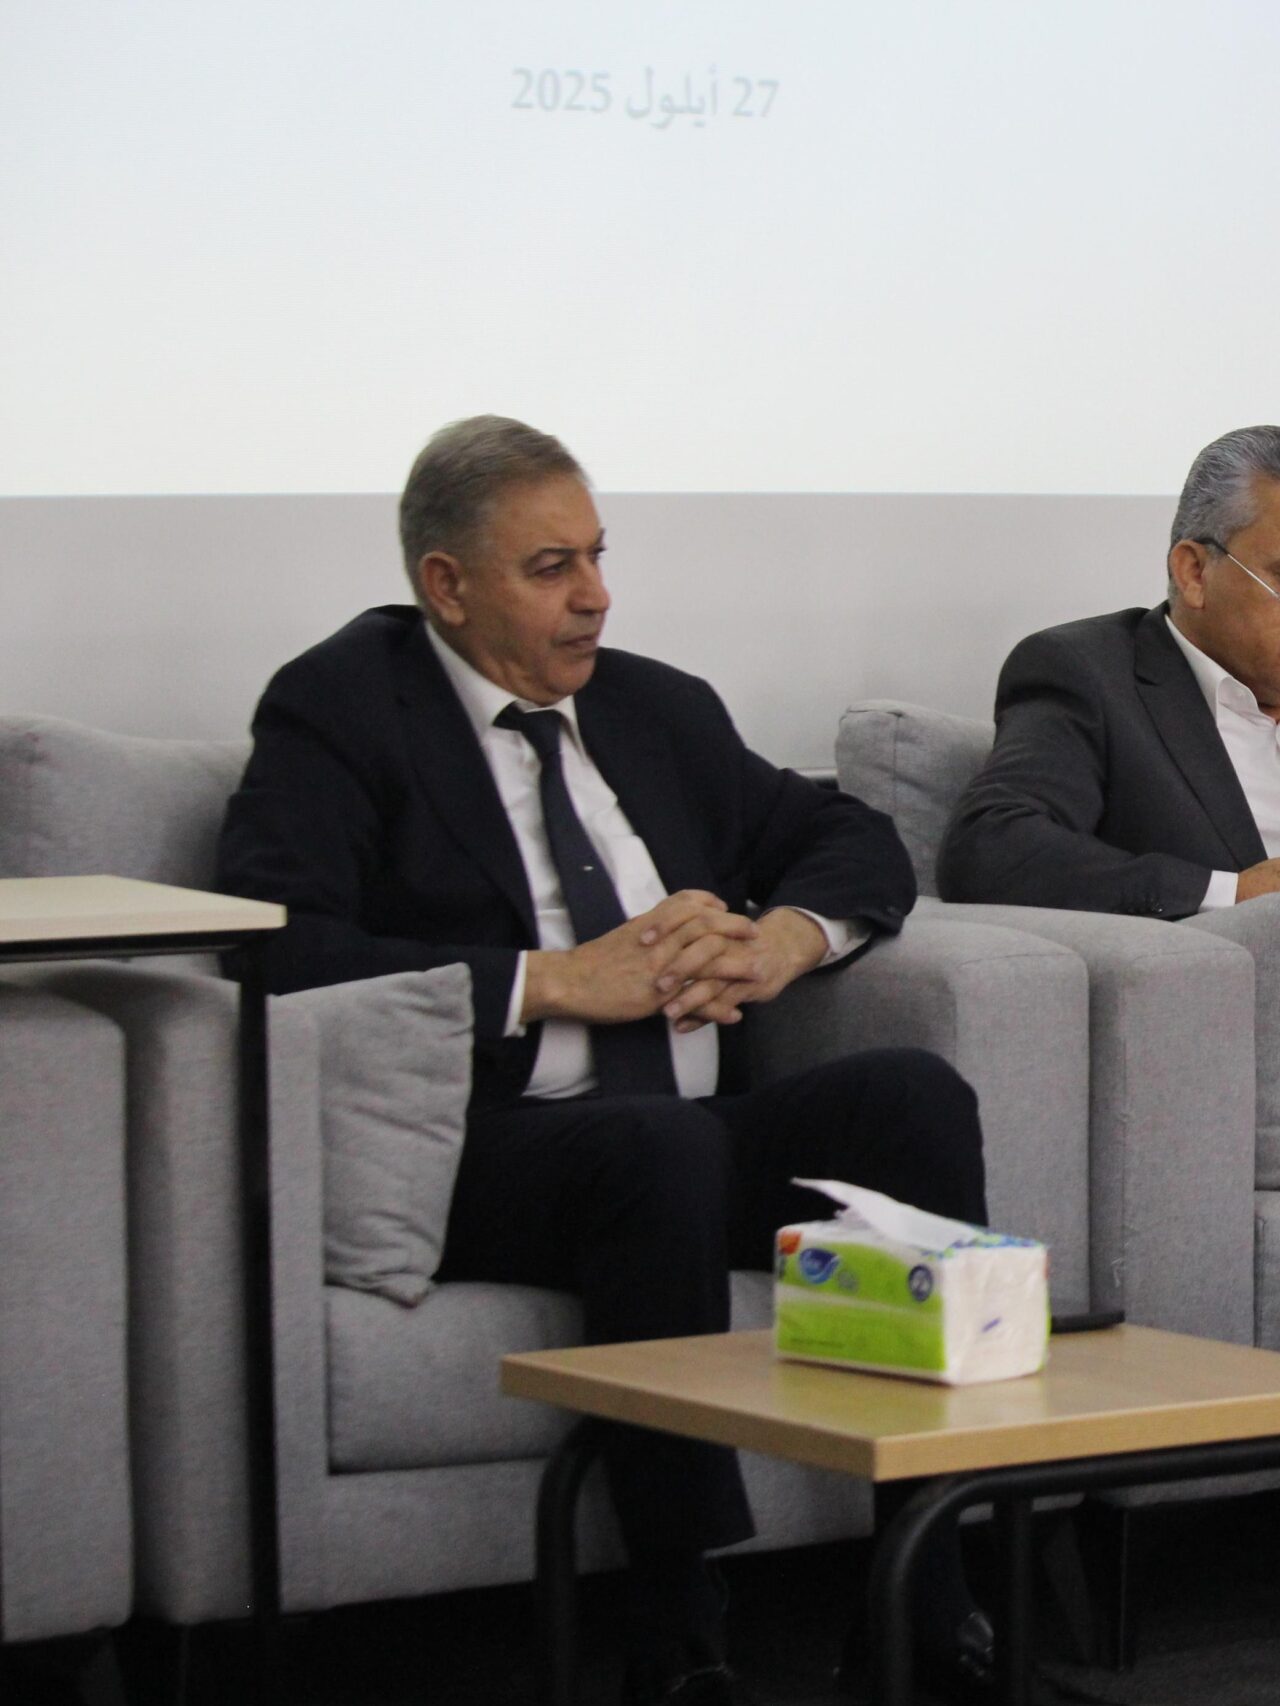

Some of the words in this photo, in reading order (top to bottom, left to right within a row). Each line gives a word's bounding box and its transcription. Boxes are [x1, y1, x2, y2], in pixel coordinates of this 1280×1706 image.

[510, 66, 613, 113] 2025
[625, 63, 718, 129] أيلول
[731, 75, 780, 118] 27
